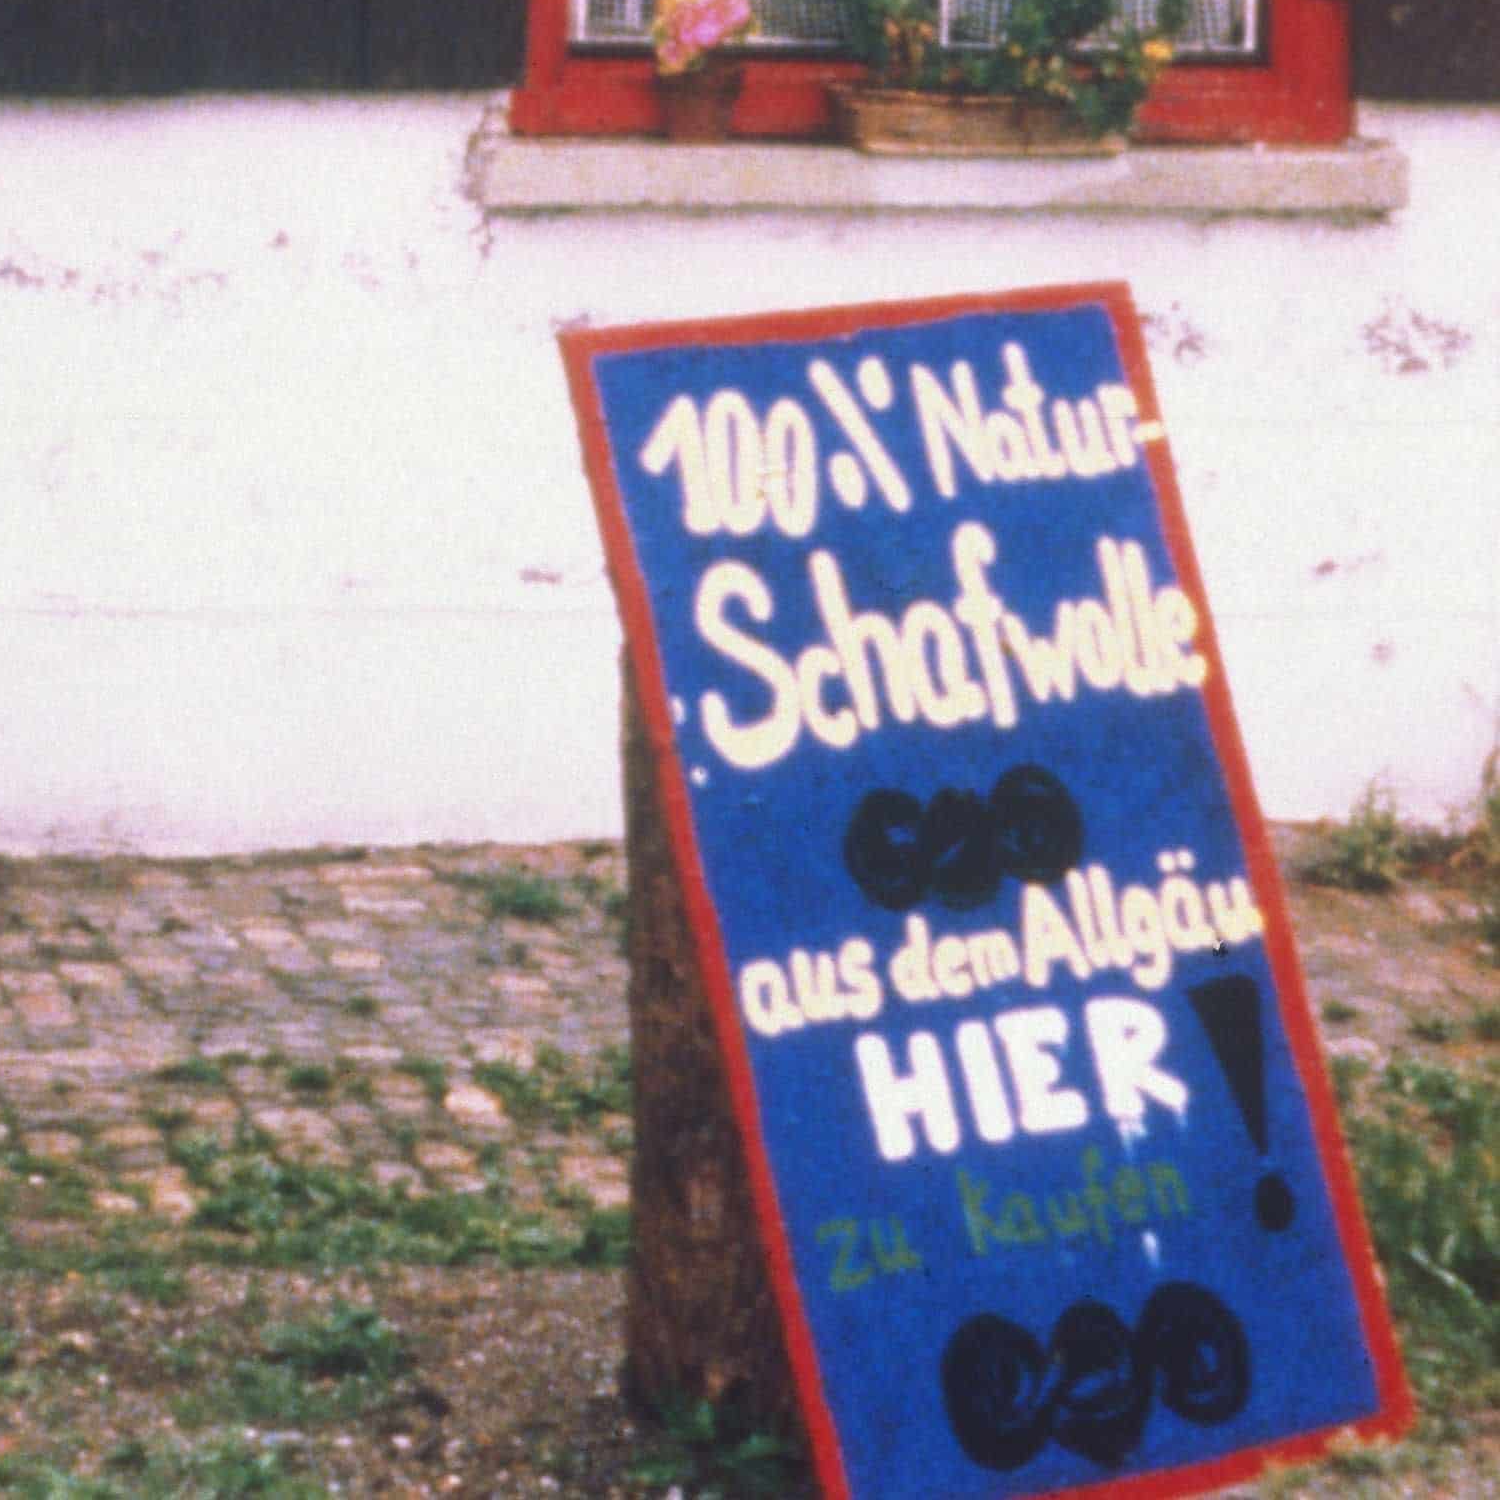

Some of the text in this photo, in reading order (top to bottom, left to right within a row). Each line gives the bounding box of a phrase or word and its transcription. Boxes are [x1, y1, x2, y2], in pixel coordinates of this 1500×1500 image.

[910, 342, 1165, 498] Natur-
[695, 521, 1208, 770] Schafwolle
[739, 850, 1267, 1036] aus dem Allgäu
